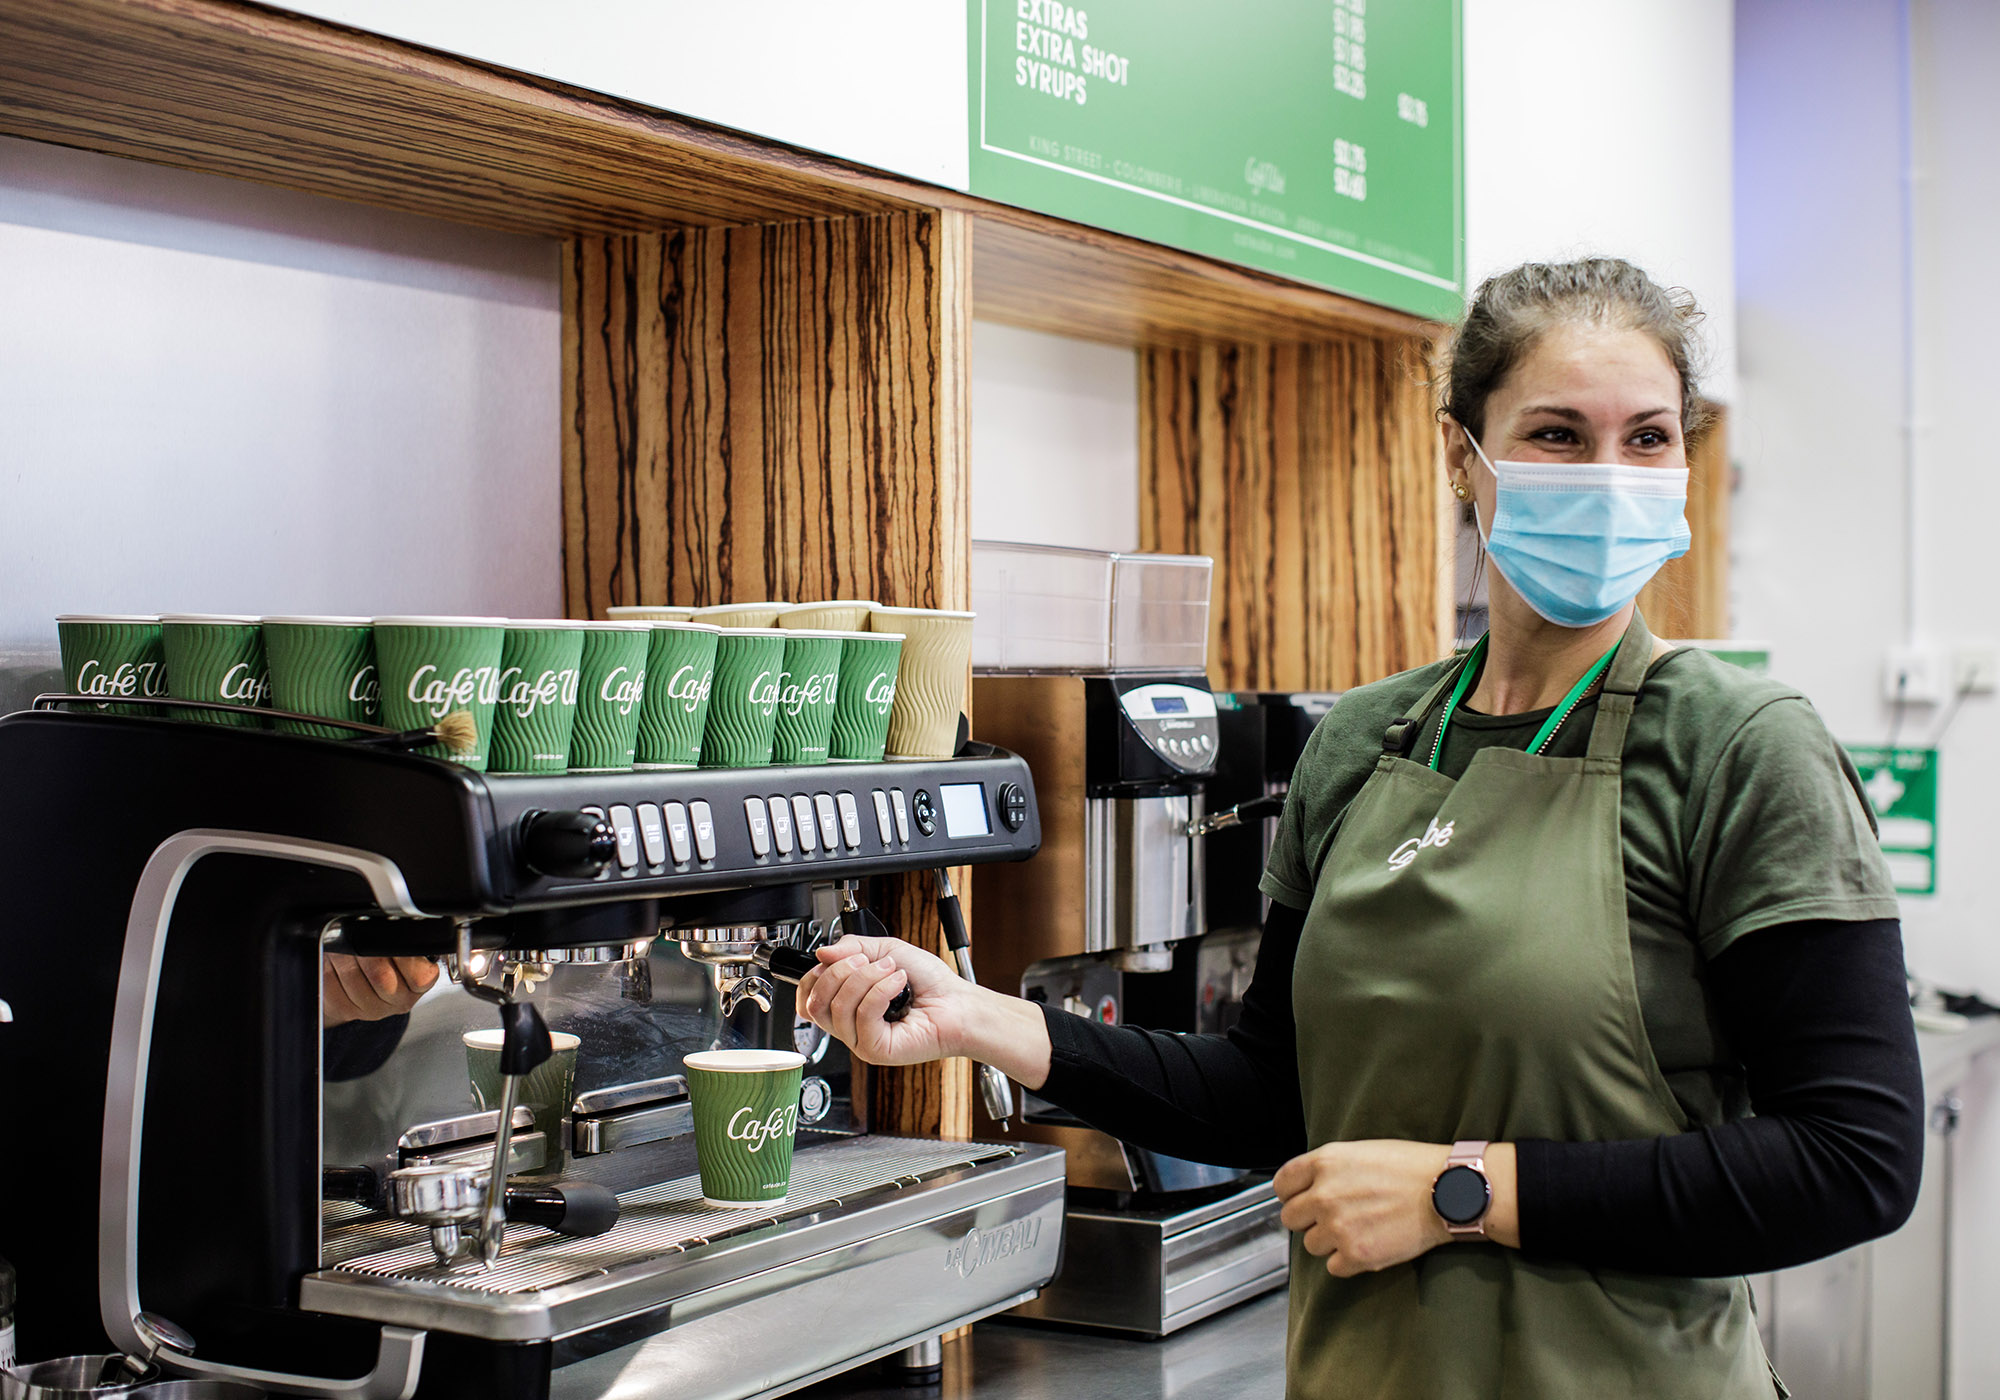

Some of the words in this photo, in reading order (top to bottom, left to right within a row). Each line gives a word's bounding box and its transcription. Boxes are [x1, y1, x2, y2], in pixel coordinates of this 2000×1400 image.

[1017, 0, 1088, 40] EXTRAS
[1016, 20, 1077, 69] EXTRA
[1081, 44, 1129, 86] SHOT
[1015, 55, 1087, 105] SYRUPS
[77, 660, 136, 709] Café
[408, 664, 475, 718] Café
[496, 667, 558, 718] Café
[779, 672, 822, 716] Café
[727, 1106, 784, 1153] Café
